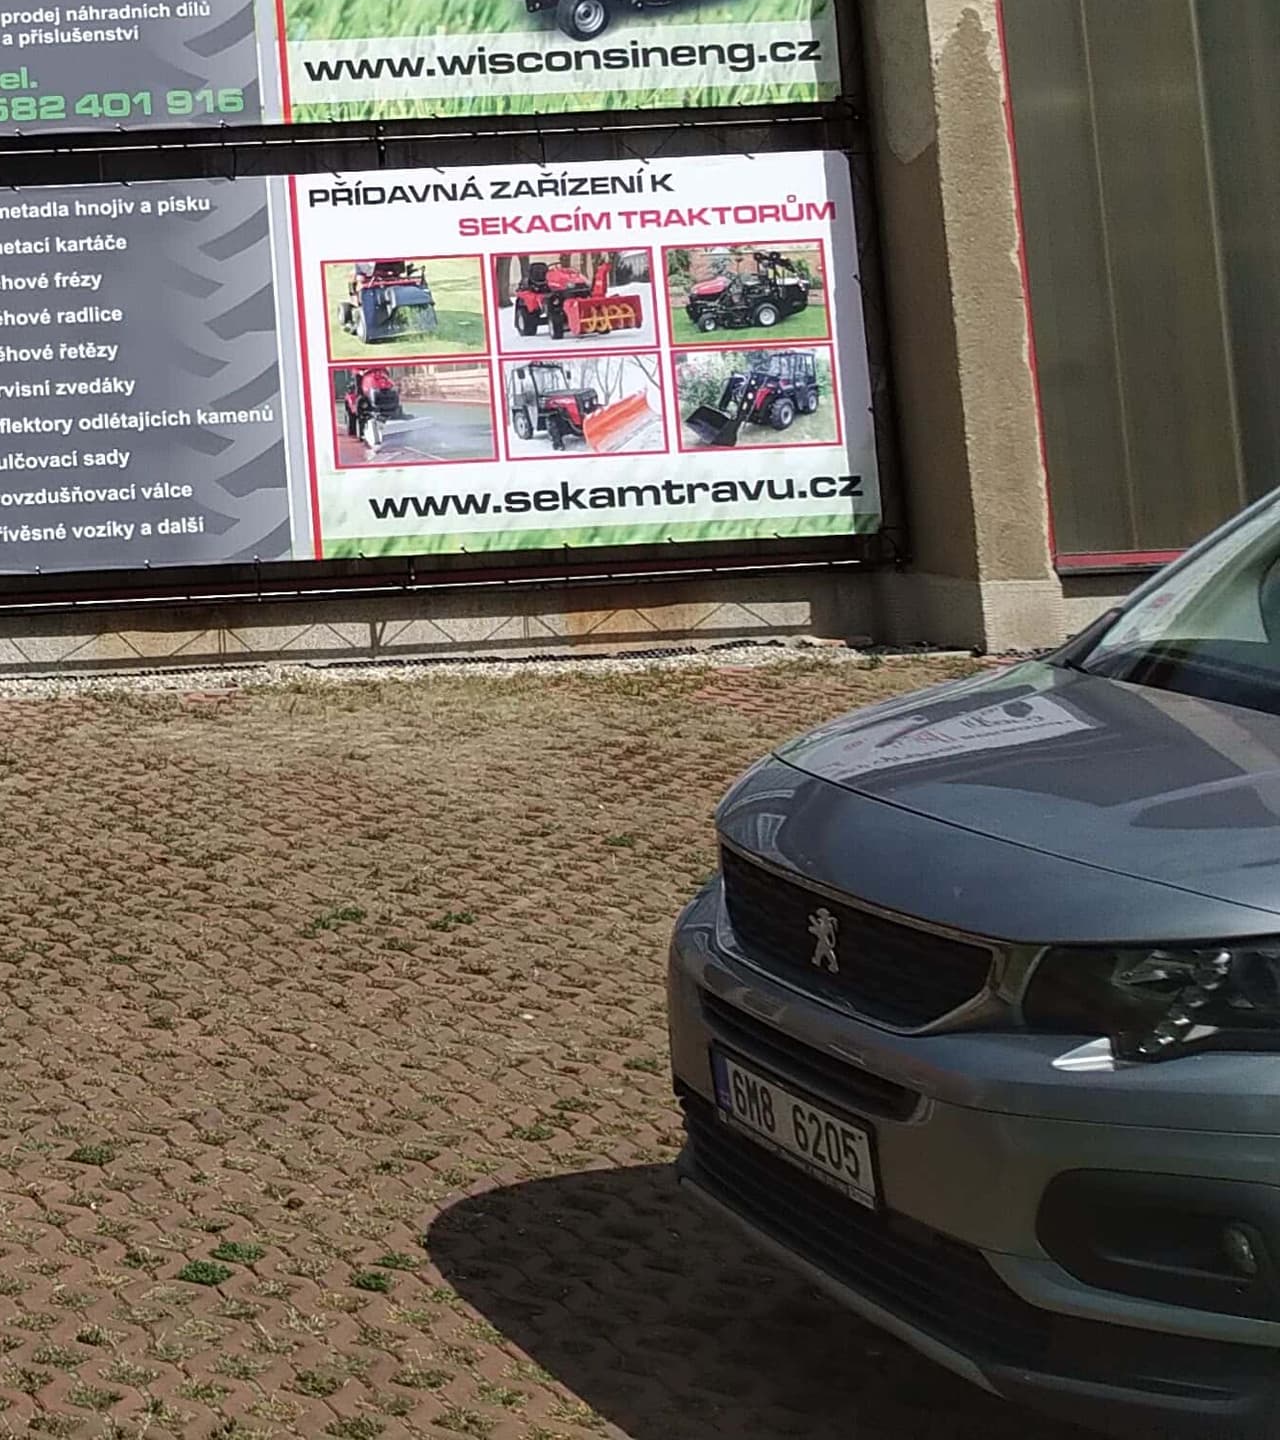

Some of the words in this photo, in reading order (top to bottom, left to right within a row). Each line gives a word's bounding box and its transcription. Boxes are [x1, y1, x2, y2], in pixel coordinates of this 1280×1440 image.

[1, 7, 61, 27] prodej
[66, 2, 170, 21] náhradních
[175, 0, 211, 17] dílů
[2, 33, 13, 45] a
[18, 25, 140, 48] příslušenství
[304, 39, 822, 82] www.wisconsineng.cz
[75, 91, 152, 118] 401
[166, 87, 245, 115] 916
[308, 175, 484, 208] PŘÍDAVNÁ
[490, 168, 644, 200] ZAŘÍZENÍ
[650, 173, 675, 192] K
[75, 200, 135, 218] hnojiv
[140, 201, 152, 213] a
[157, 196, 211, 215] písku
[458, 206, 611, 237] SEKACÍM
[618, 194, 836, 229] TRAKTORŮM
[55, 235, 127, 252] kartáče
[54, 272, 102, 290] frézy
[57, 306, 123, 323] radlice
[59, 343, 118, 361] řetězy
[56, 377, 135, 396] zvedáky
[79, 411, 191, 431] odlétajících
[196, 405, 274, 424] kamenů
[84, 449, 130, 468] sady
[141, 482, 193, 499] válce
[368, 474, 863, 519] www.sekamtravu.cz
[72, 521, 134, 541] vozíky
[140, 522, 152, 535] a
[157, 517, 204, 534] další
[732, 1069, 776, 1134] 6M8
[792, 1104, 860, 1183] 6205
